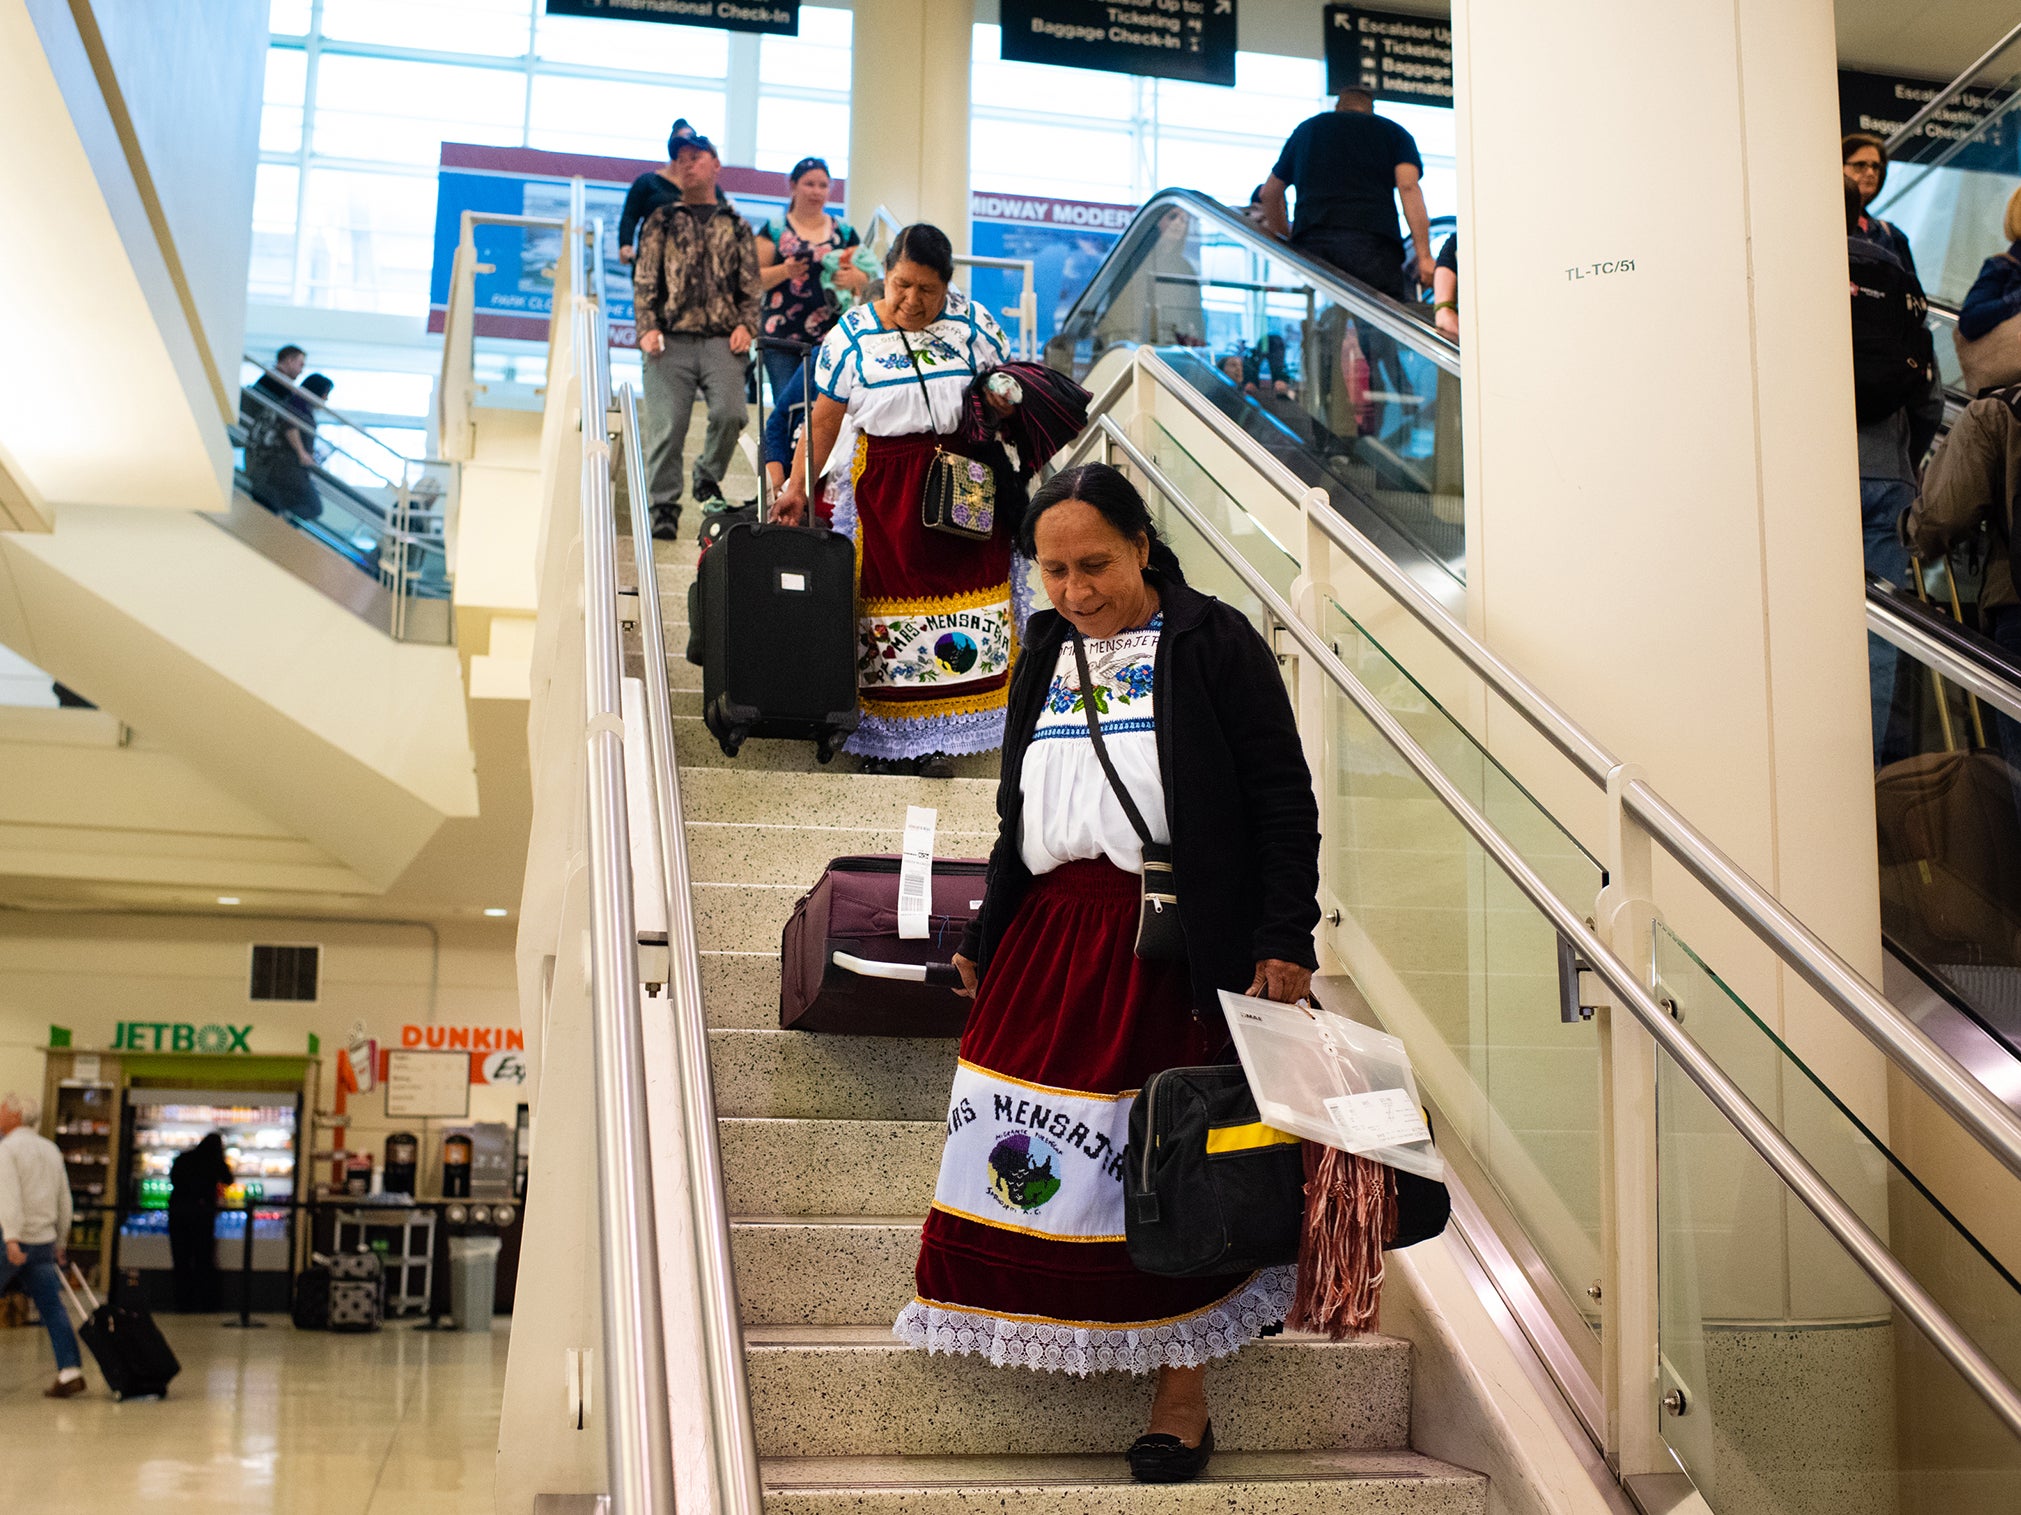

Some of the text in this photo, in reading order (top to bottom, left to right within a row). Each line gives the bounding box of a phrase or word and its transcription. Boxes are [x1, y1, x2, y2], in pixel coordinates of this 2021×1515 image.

[717, 3, 791, 24] Check-In
[1106, 7, 1181, 33] Ticketing
[1031, 17, 1181, 49] Baggage Check-In
[1358, 17, 1432, 39] Escalator
[1382, 38, 1452, 64] Ticketing
[1382, 57, 1452, 80] Baggage
[1565, 259, 1635, 281] TL-TC/51
[110, 1022, 253, 1054] JETBOX
